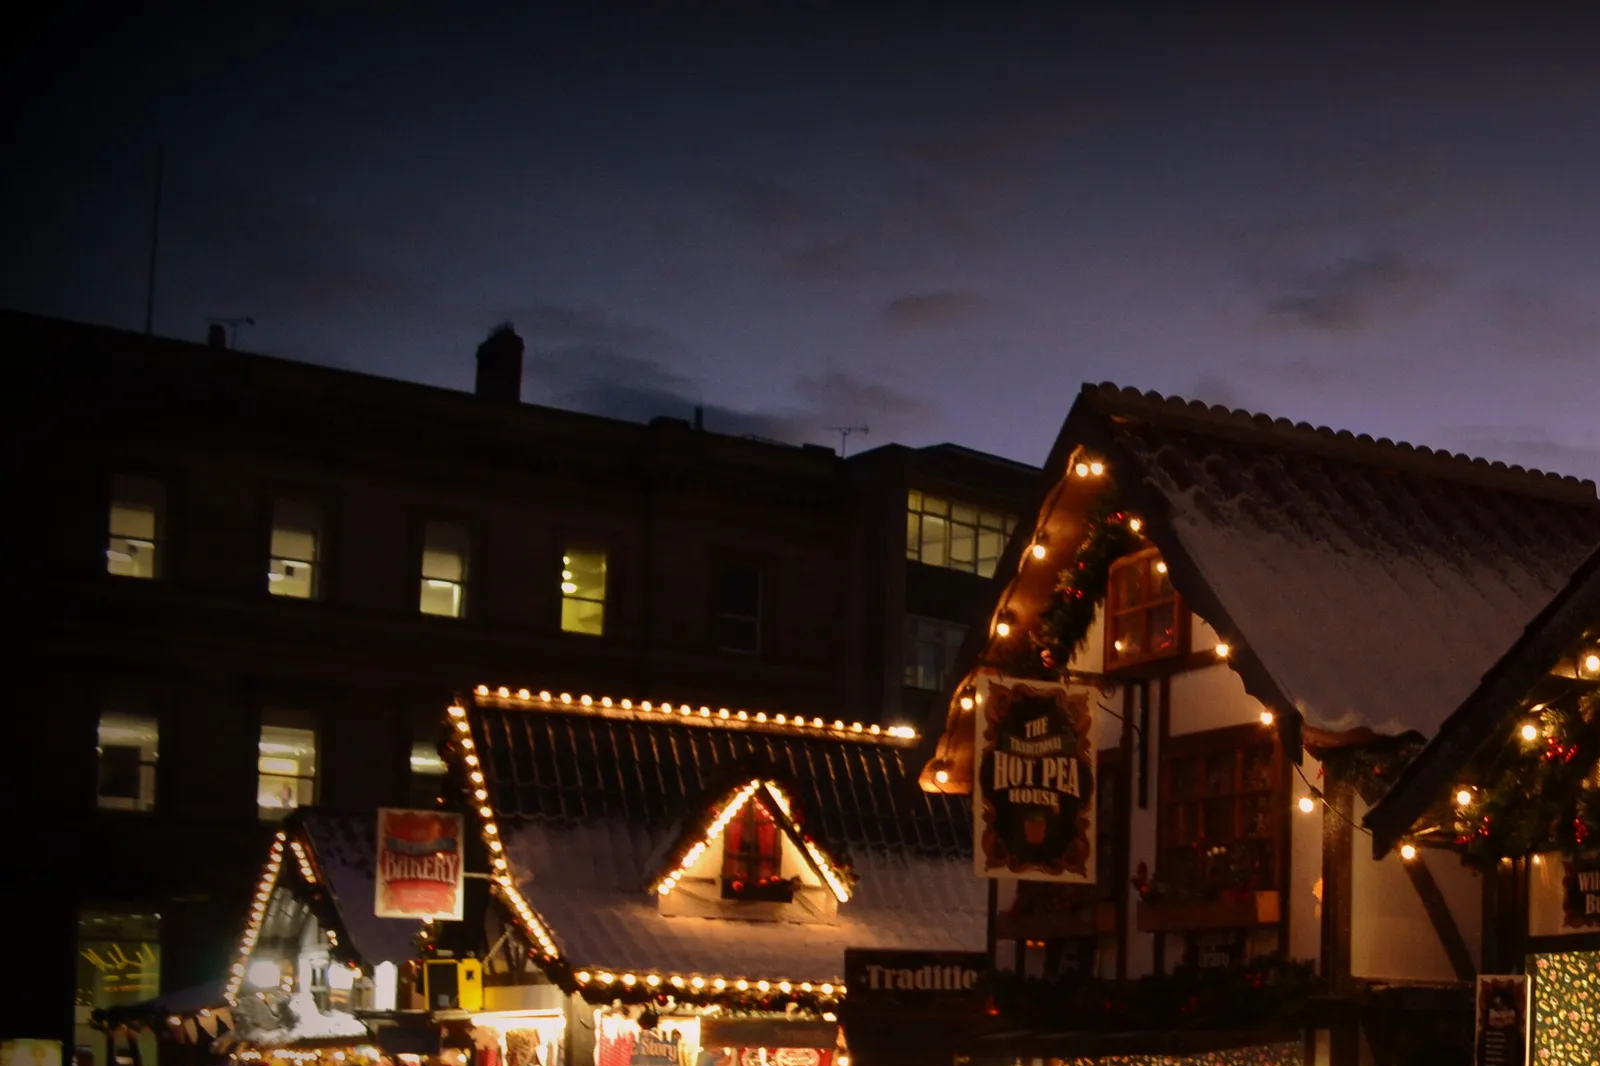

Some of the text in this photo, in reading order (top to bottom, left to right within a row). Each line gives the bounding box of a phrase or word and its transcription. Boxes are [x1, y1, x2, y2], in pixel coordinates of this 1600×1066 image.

[1024, 715, 1049, 739] THE
[993, 750, 1081, 799] HOT PEA
[1007, 787, 1060, 807] HOUSE
